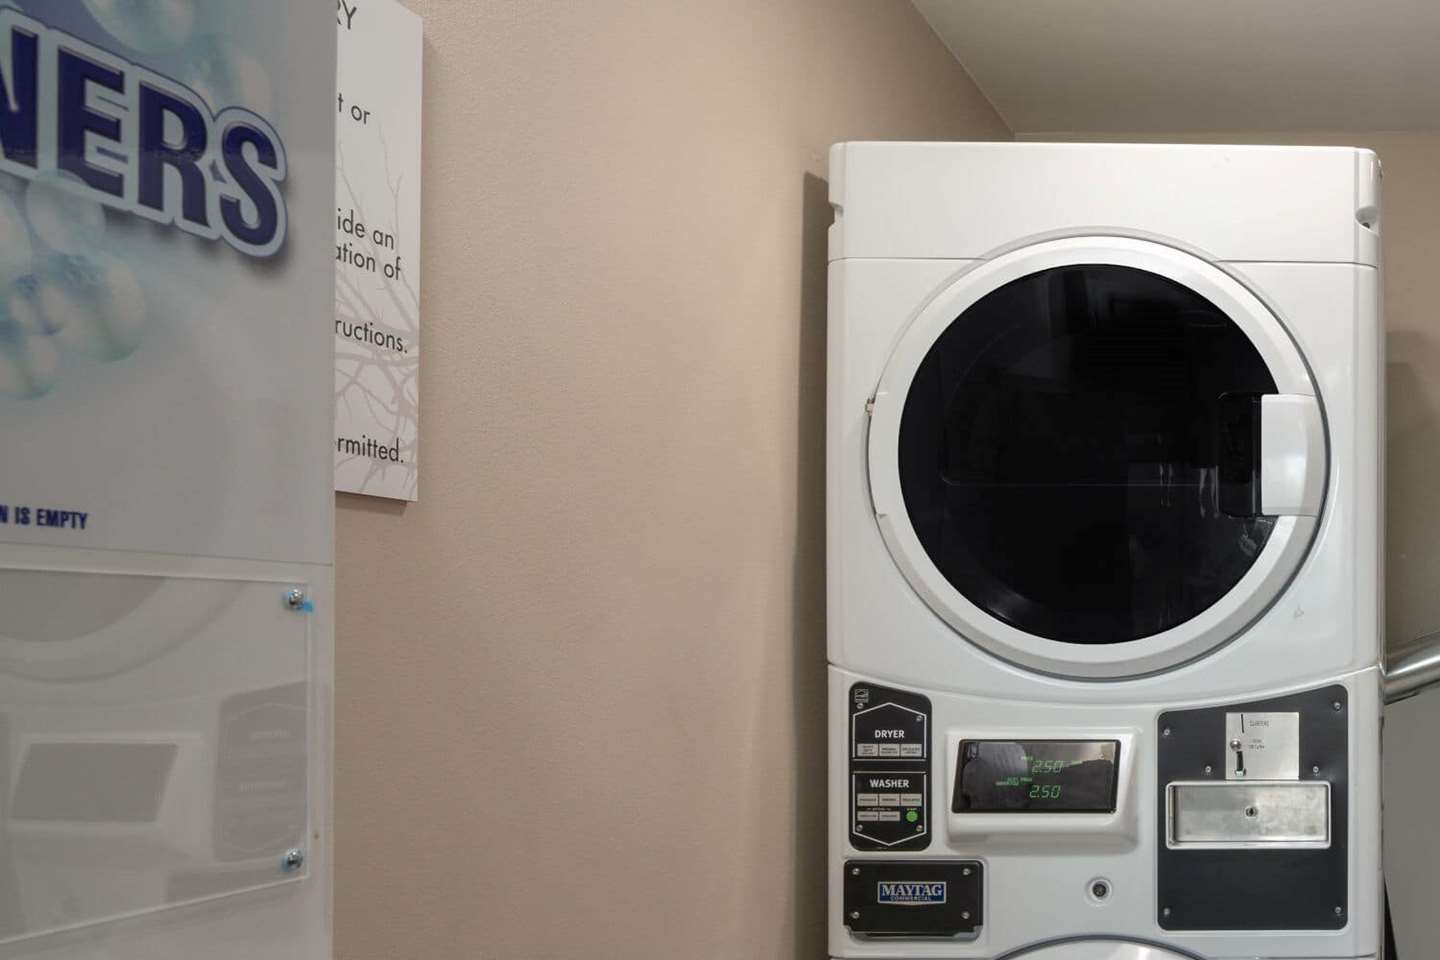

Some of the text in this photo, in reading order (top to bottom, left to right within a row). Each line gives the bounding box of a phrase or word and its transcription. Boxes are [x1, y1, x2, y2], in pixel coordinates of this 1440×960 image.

[351, 105, 371, 125] or
[0, 22, 282, 250] NERS
[337, 207, 394, 250] ide an
[383, 256, 402, 281] of
[337, 434, 404, 464] rmitted.
[15, 506, 31, 526] IS
[36, 508, 88, 531] EMPTY
[874, 729, 905, 739] DRYER
[1031, 760, 1063, 774] 2.50
[869, 779, 910, 788] WASHER
[1029, 785, 1061, 799] 2.50
[882, 884, 943, 896] MAYTAG
